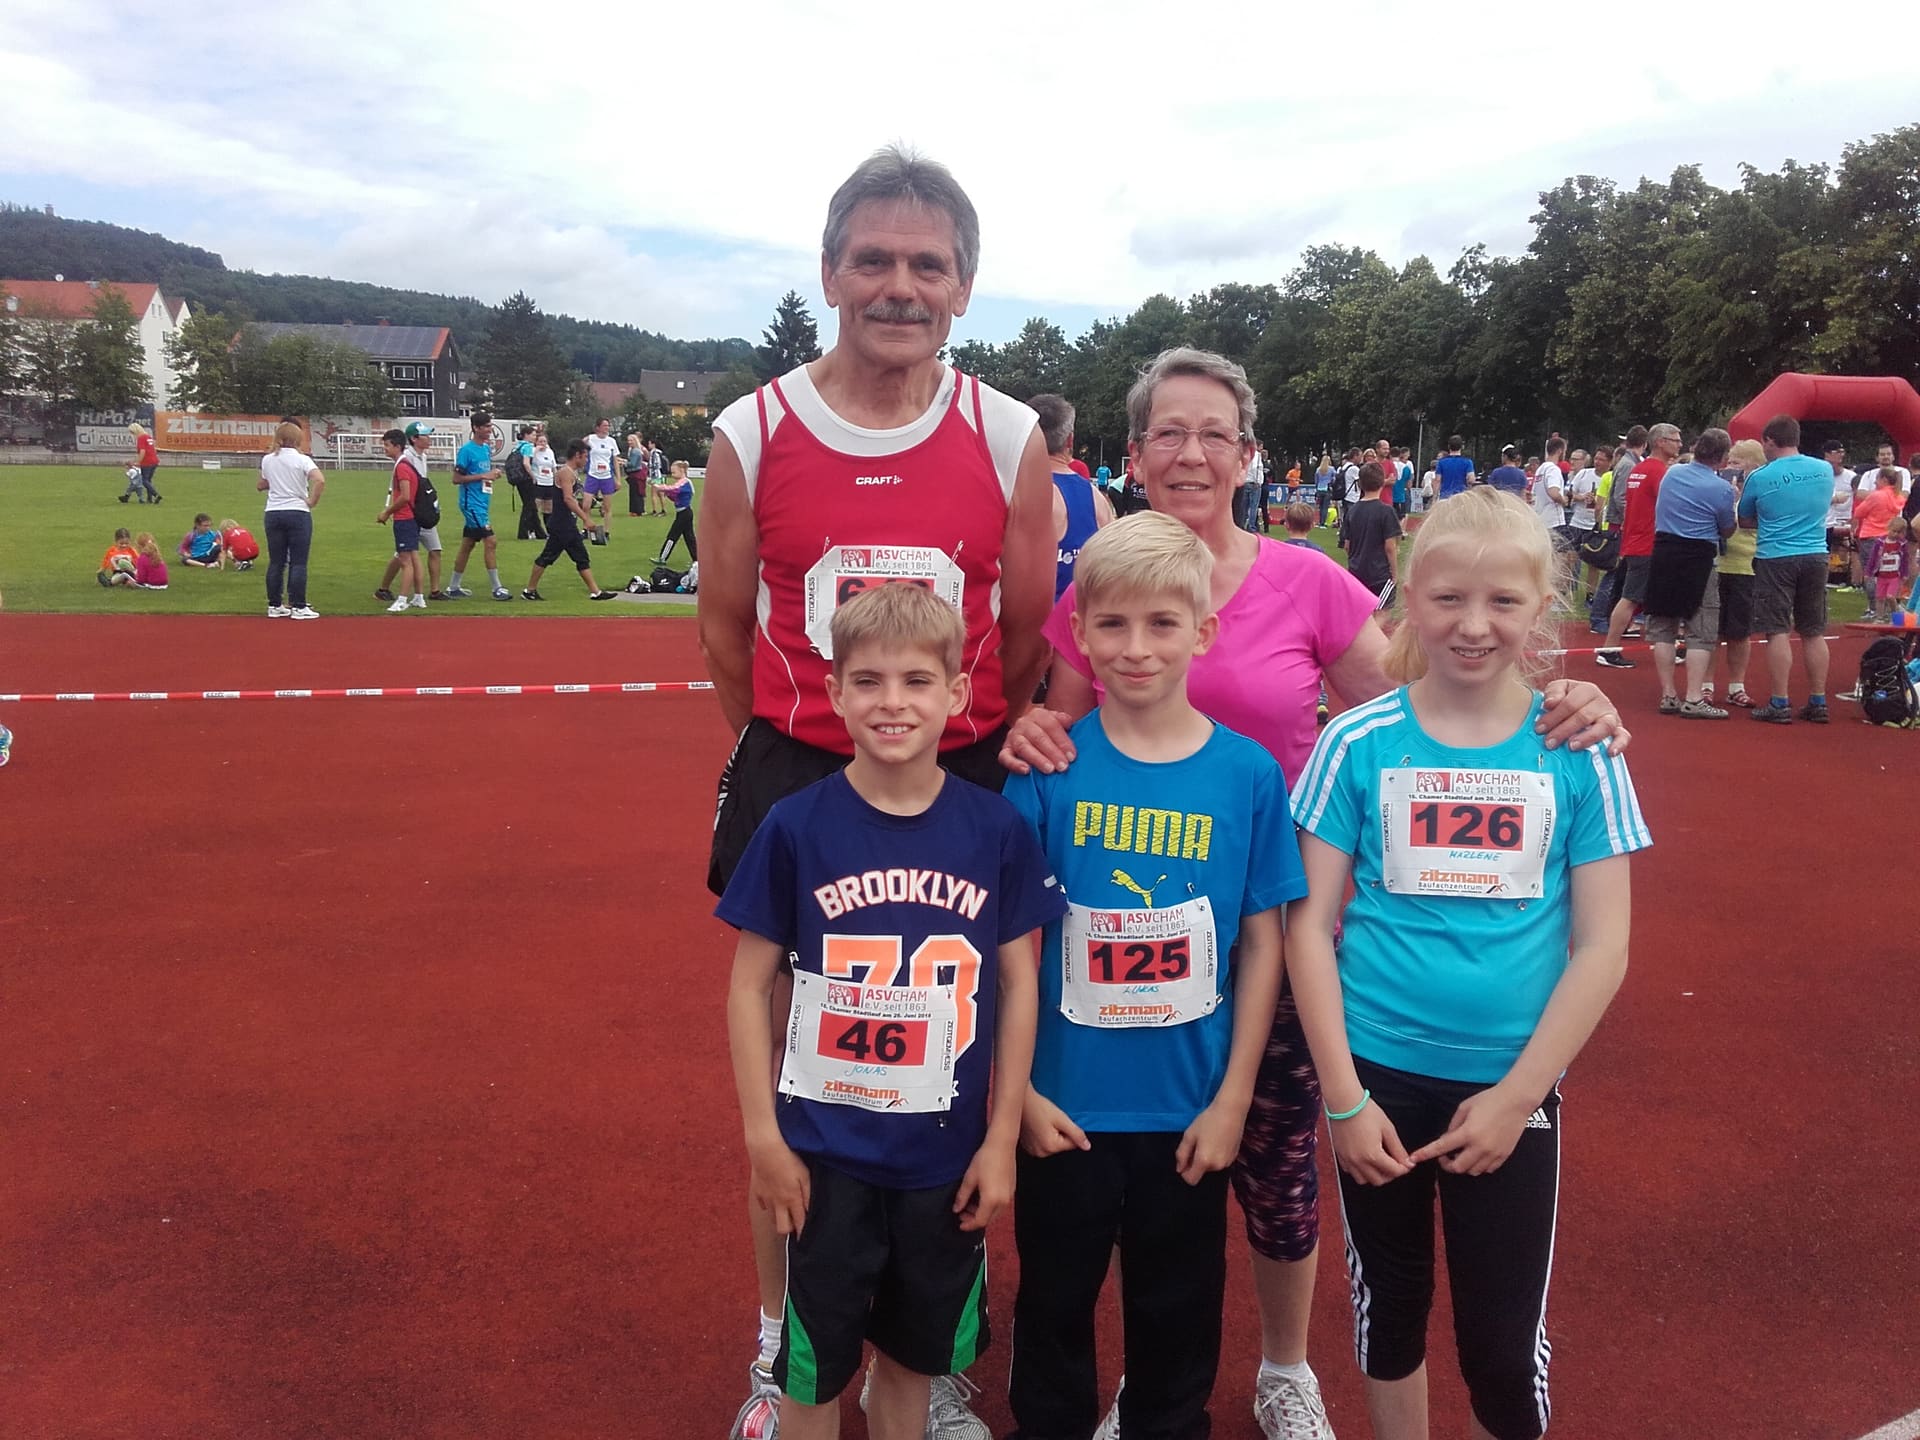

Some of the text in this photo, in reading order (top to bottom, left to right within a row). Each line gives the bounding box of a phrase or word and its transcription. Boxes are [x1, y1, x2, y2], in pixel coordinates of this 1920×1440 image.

[100, 432, 135, 448] ALTMA
[855, 475, 893, 485] CRAFT
[876, 550, 932, 560] ASVCHAM
[876, 560, 932, 570] e.V. seit 1863
[1455, 772, 1520, 785] ASVCHAM
[1455, 785, 1520, 795] e.V. seit 1863
[1073, 800, 1213, 861] PUMA
[1414, 804, 1521, 848] 126
[1420, 869, 1500, 884] zitzmann
[814, 868, 989, 921] BROOKLYN
[1126, 908, 1185, 924] ASVCHAM
[1127, 920, 1185, 932] e.V. seit 1863
[1092, 940, 1188, 982] 125
[866, 988, 927, 1002] ASVCHAM
[864, 1002, 926, 1012] e.V. seit 1863
[1099, 1004, 1172, 1016] zitzmann
[836, 1020, 908, 1063] 46
[844, 1064, 888, 1077] JONAS
[824, 1080, 900, 1099] zitzmann
[1524, 1120, 1552, 1129] adidas
